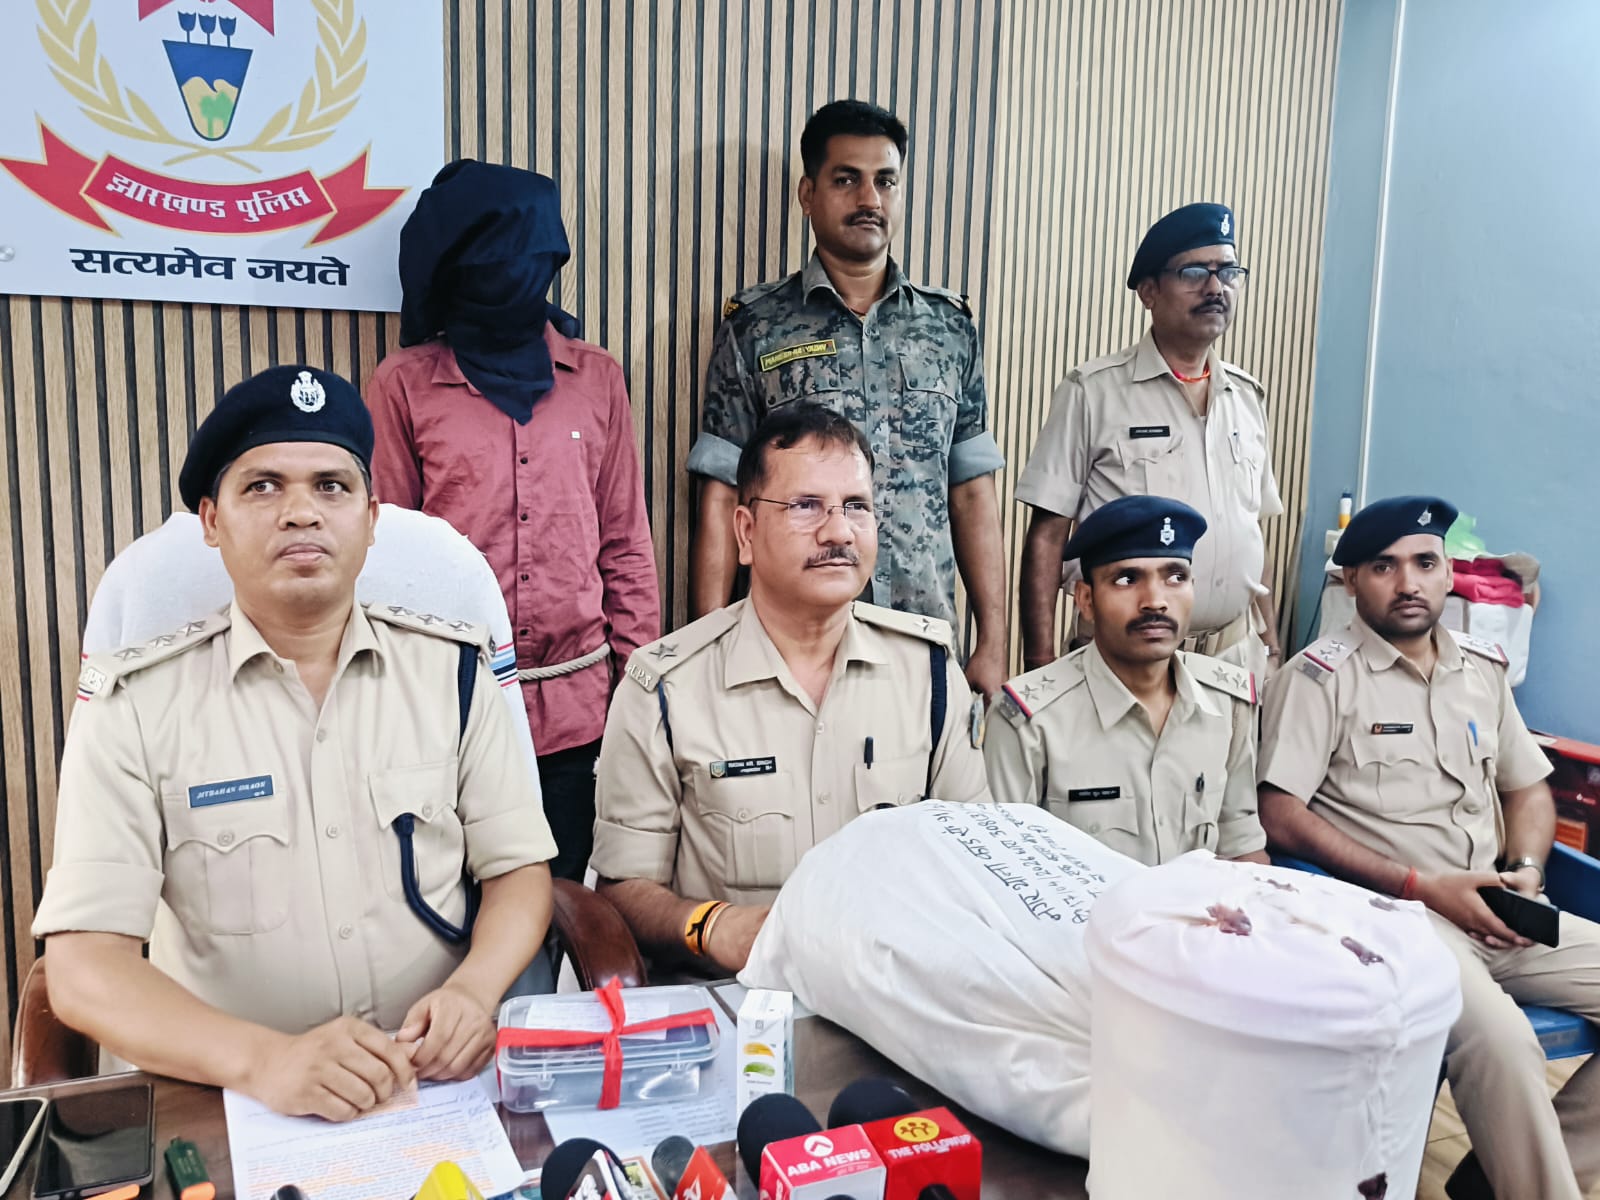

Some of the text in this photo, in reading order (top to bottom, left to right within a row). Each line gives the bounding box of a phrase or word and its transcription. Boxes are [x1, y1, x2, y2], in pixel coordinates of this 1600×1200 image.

[106, 172, 312, 222] झारखण्ड पुलिस
[69, 247, 350, 286] सत्यमेव जयते
[983, 862, 1029, 891] थाना
[1018, 888, 1062, 921] नगर
[787, 1161, 822, 1178] ABA
[823, 1148, 872, 1168] NEWS
[887, 1147, 914, 1159] THE
